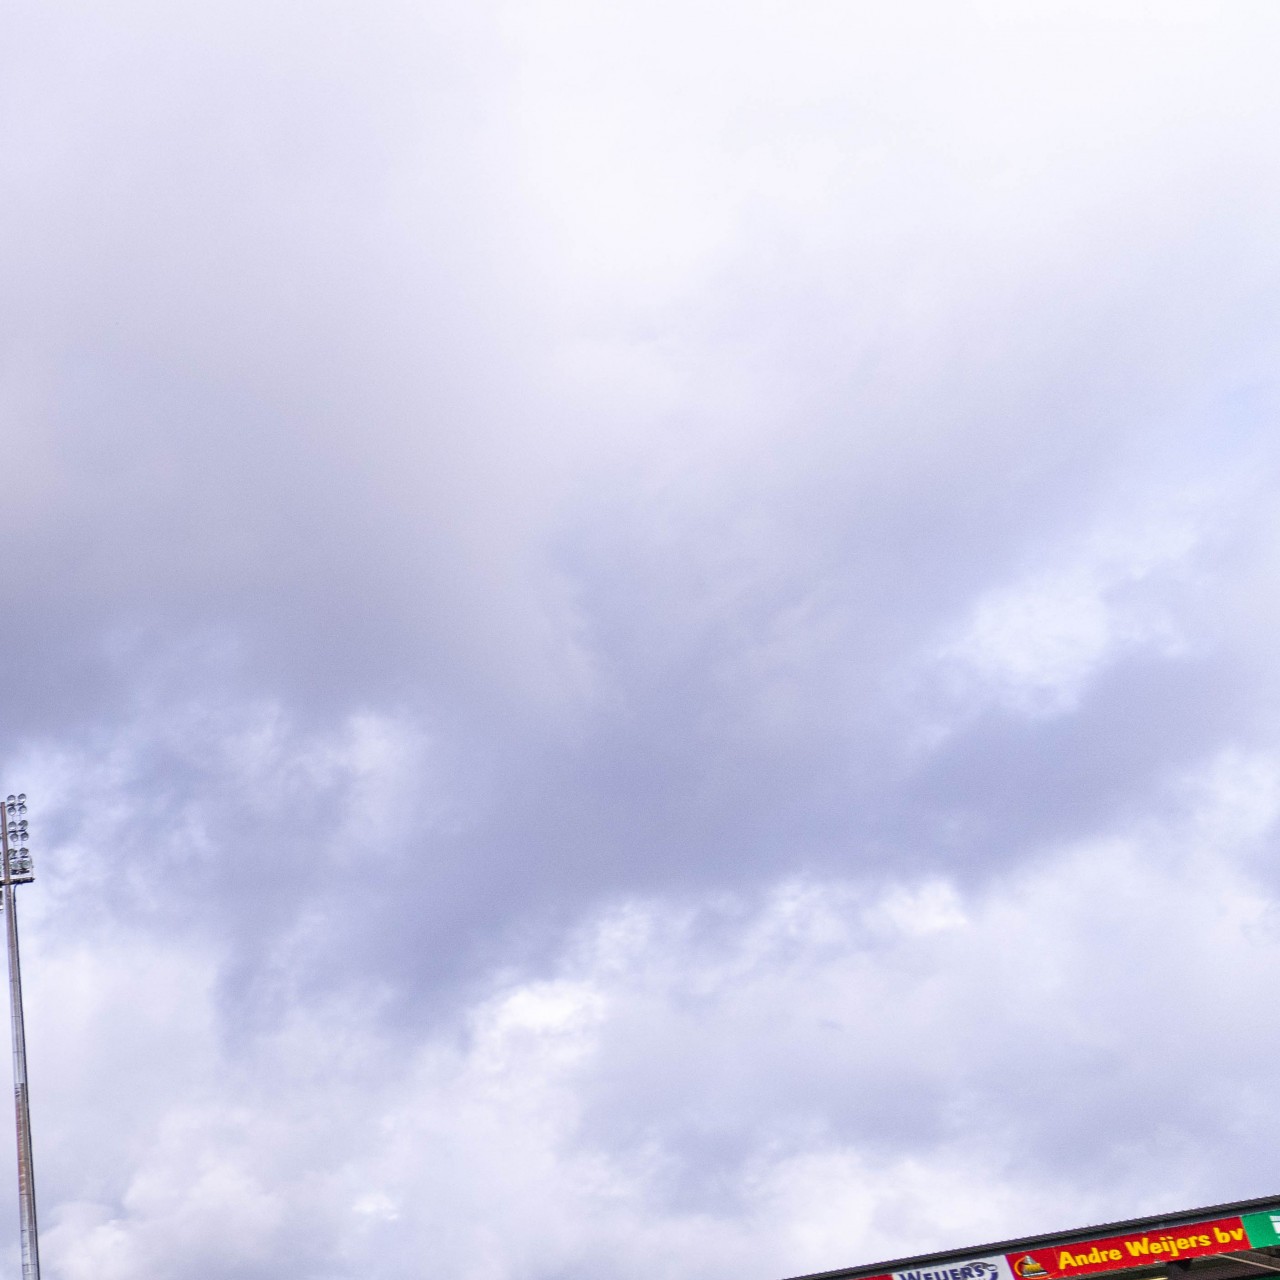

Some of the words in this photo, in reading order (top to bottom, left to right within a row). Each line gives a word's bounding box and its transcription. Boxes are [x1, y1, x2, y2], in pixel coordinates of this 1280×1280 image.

[1059, 1247, 1123, 1270] Andre
[1125, 1234, 1212, 1257] Weijers
[1212, 1227, 1244, 1243] bv
